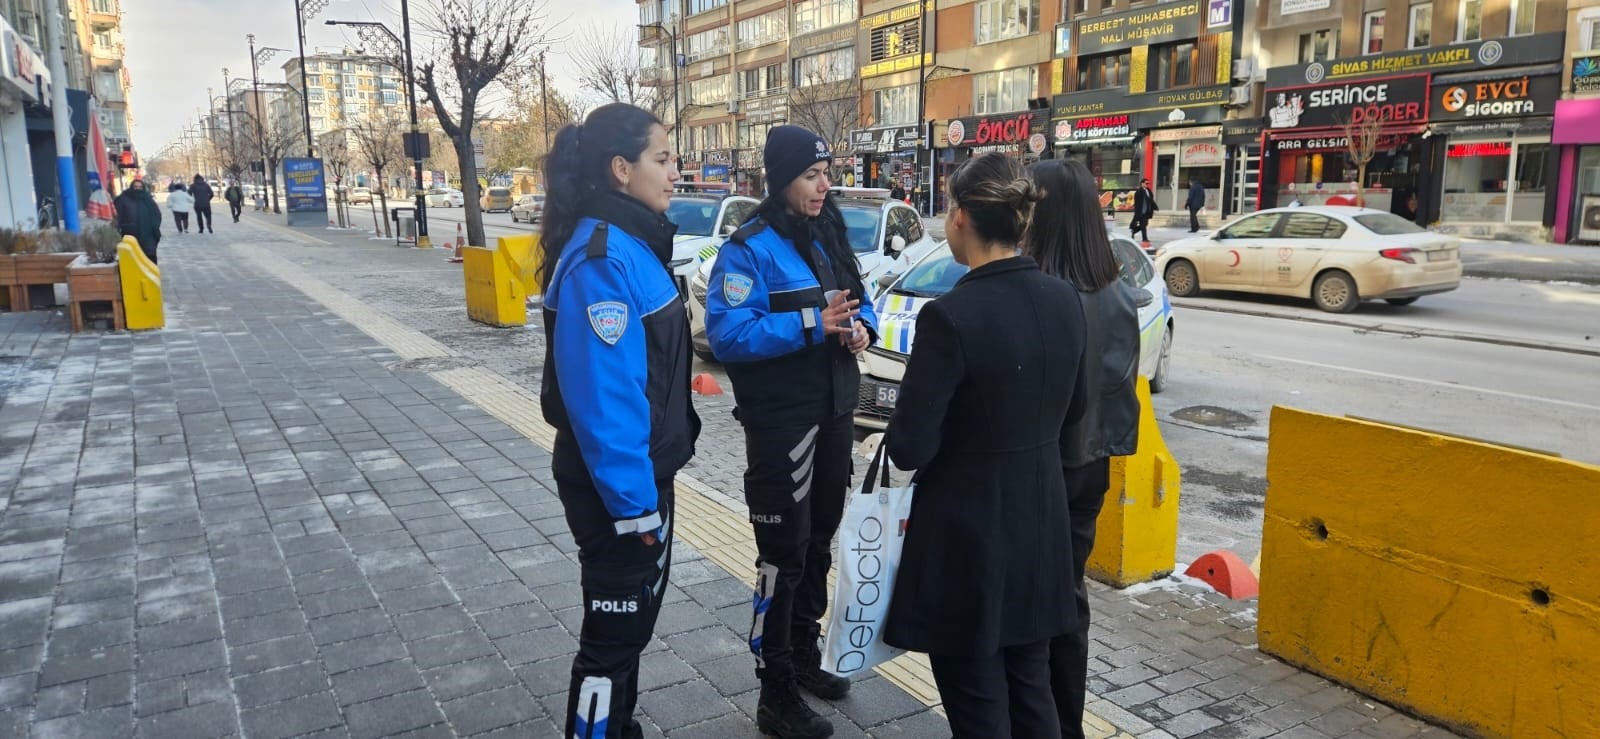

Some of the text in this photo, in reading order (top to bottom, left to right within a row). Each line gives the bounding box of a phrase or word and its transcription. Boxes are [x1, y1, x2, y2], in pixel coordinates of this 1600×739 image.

[1081, 4, 1199, 33] SERBEST MUHASEBECİ
[1101, 24, 1174, 44] MALİ MÜŞAVİR
[1332, 48, 1469, 74] SİVAS HİZMET VAKFI
[1310, 85, 1388, 107] SERİNCE
[1475, 75, 1529, 100] EVCİ
[1078, 102, 1104, 112] KANTAR
[1353, 102, 1419, 122] DÖNER
[1464, 100, 1534, 117] SİGORTA
[976, 112, 1030, 144] ÖNCÜ
[1076, 115, 1128, 129] ADIYAMAN
[1087, 125, 1129, 137] KÖFTECİSİ
[1278, 140, 1301, 150] ARA
[878, 387, 897, 402] 58
[836, 515, 883, 674] DeFacto
